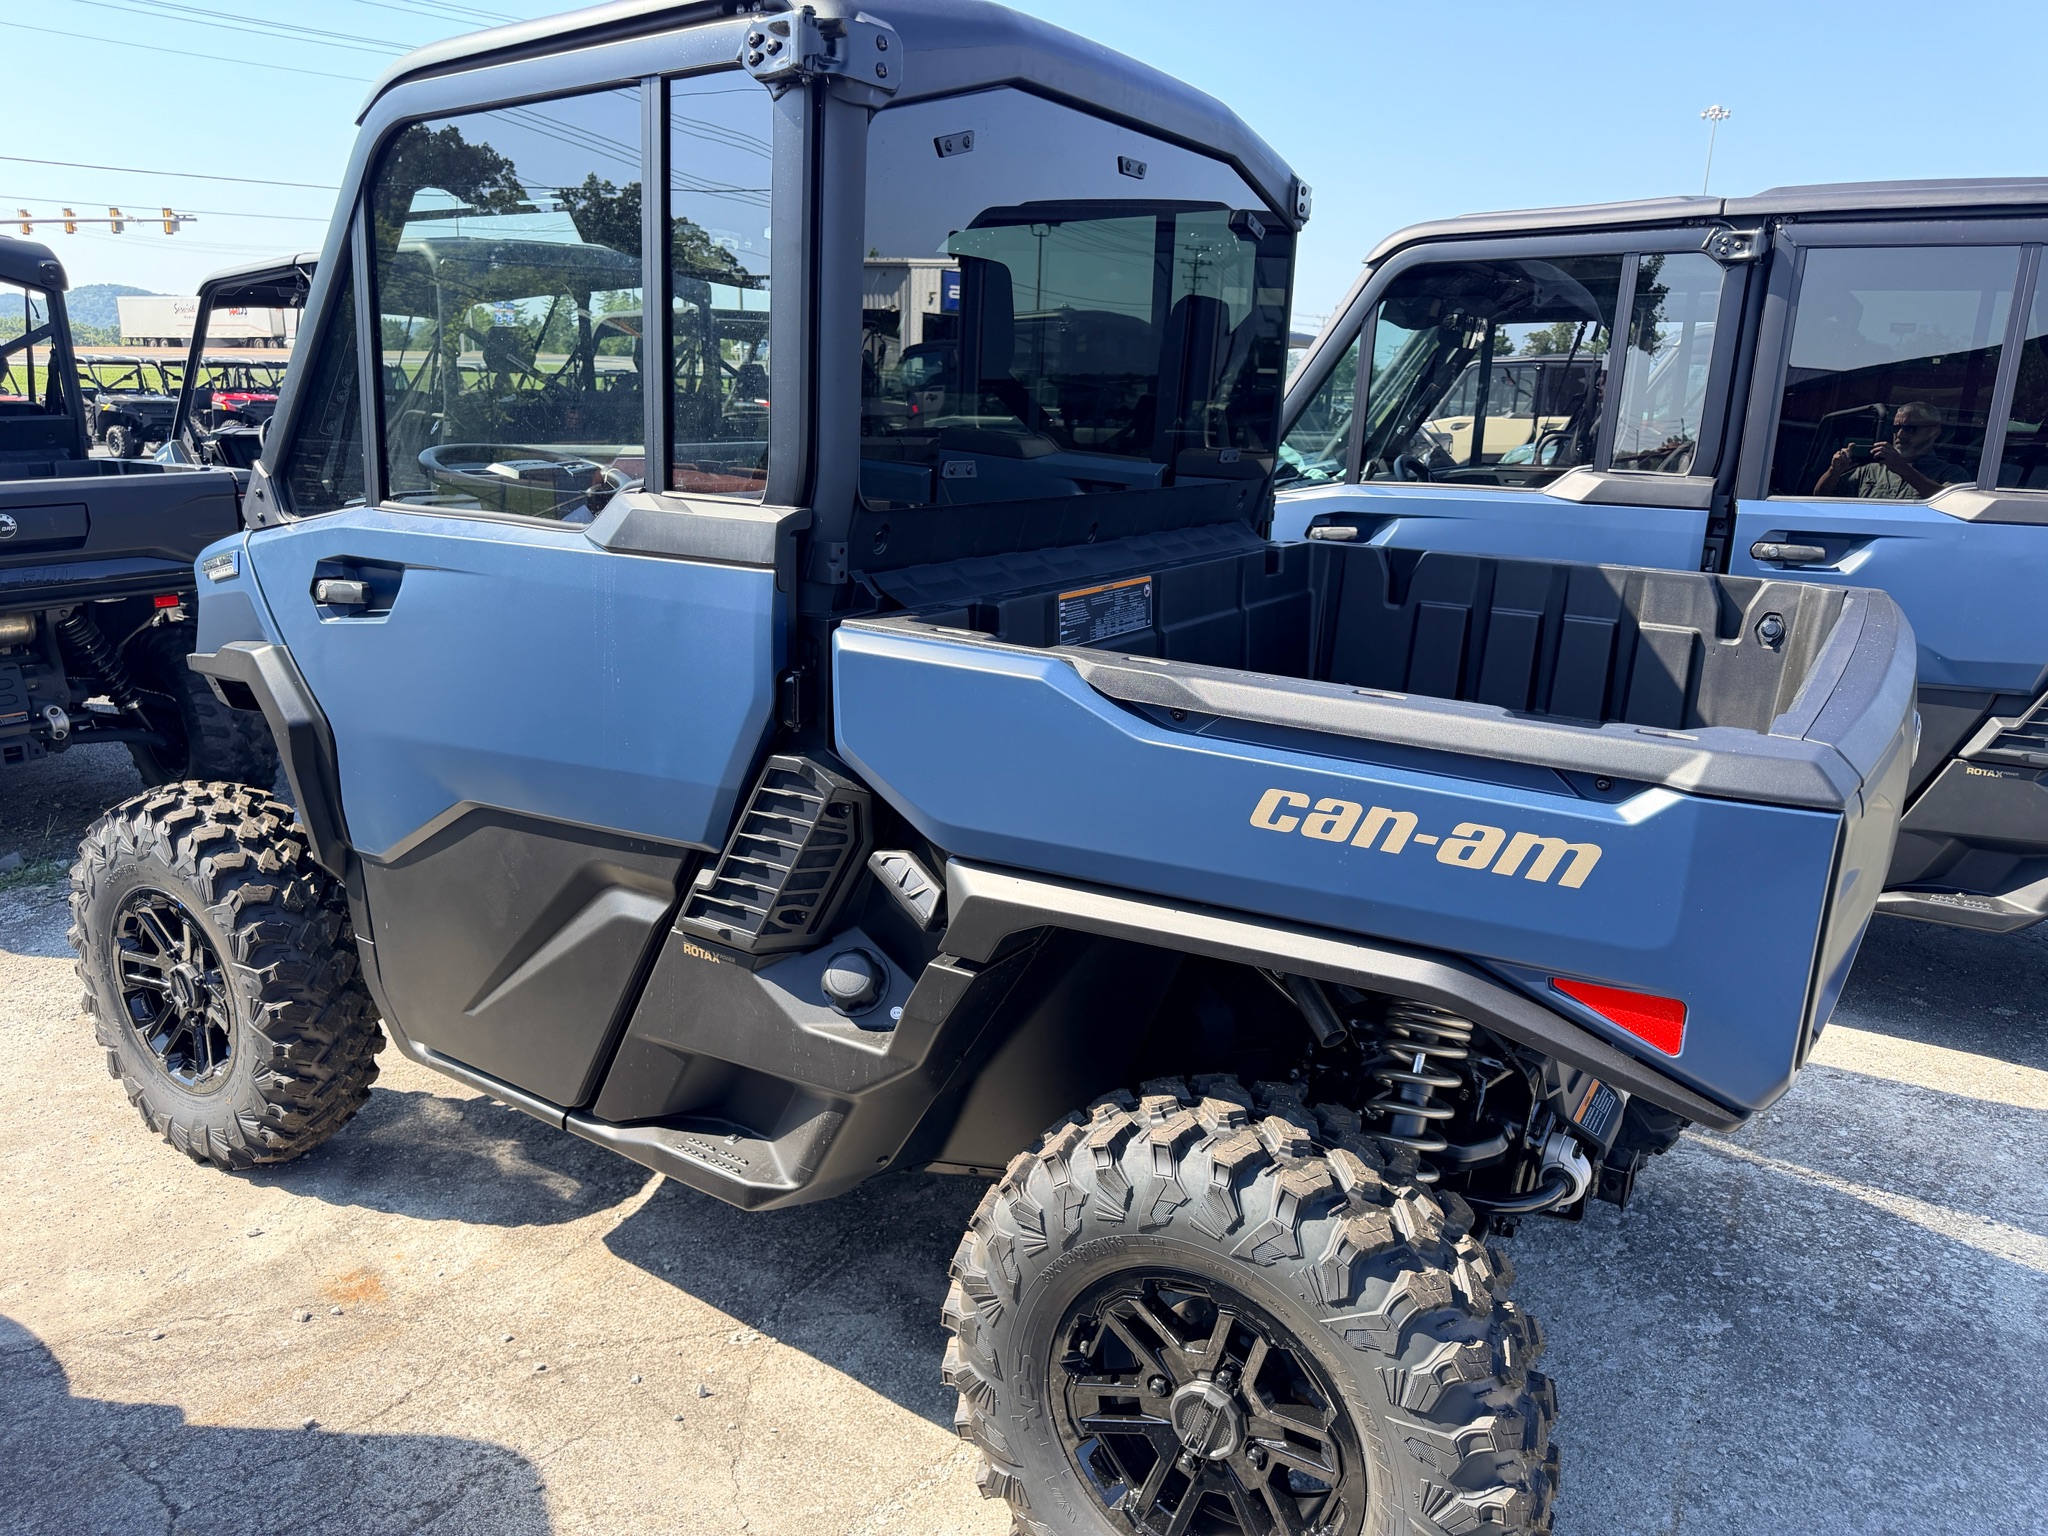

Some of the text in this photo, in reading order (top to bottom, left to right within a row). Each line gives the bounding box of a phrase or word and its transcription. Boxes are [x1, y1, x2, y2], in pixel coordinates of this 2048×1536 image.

[1966, 767, 2003, 778] ROTAX
[1250, 788, 1602, 889] can-am
[683, 943, 720, 964] ROTAX
